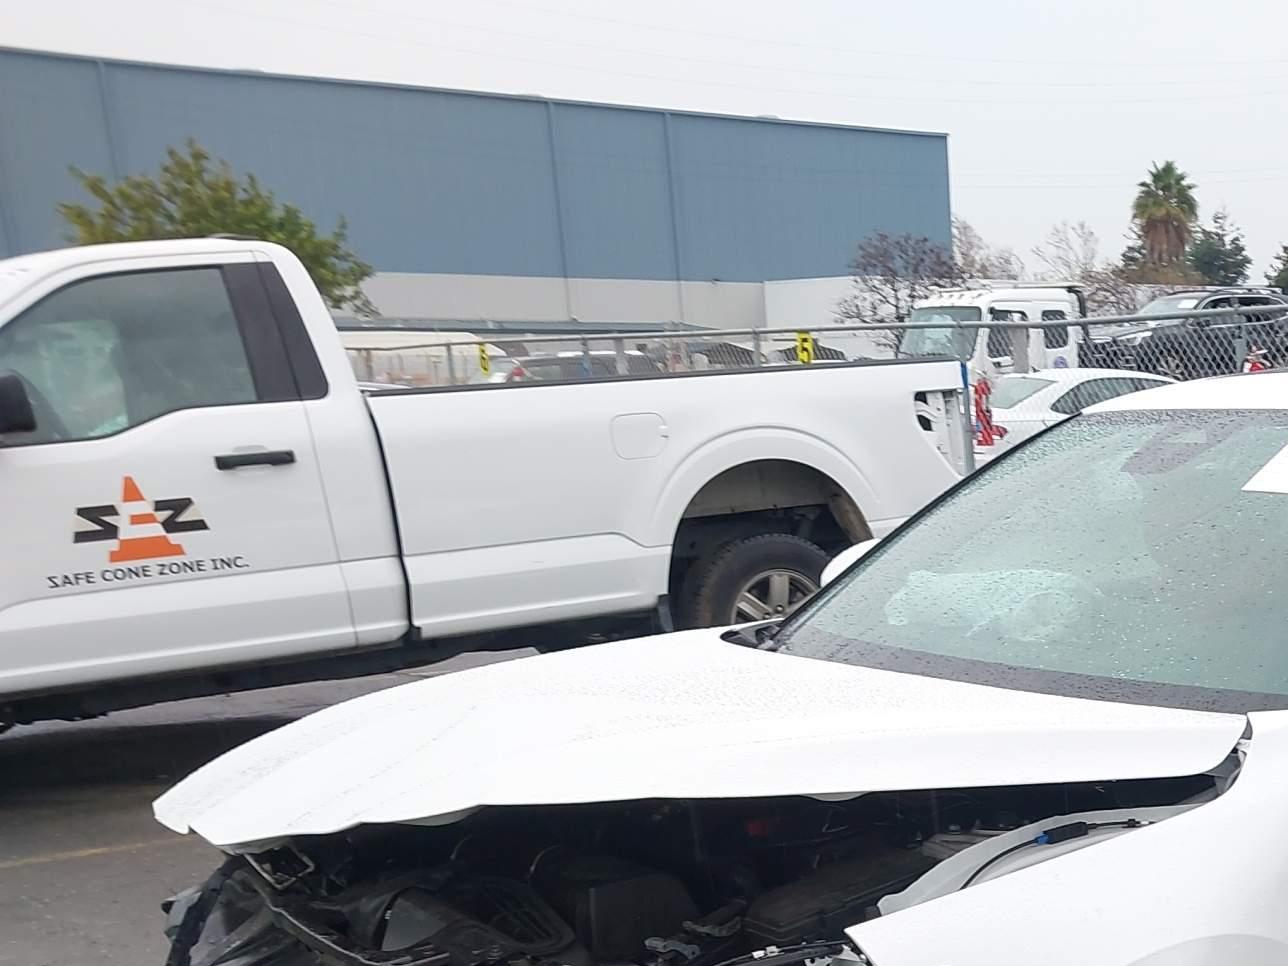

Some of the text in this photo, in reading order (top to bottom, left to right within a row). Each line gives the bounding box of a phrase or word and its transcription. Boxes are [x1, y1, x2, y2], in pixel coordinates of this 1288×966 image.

[801, 337, 811, 363] 5
[47, 556, 250, 589] SAFE CONE ZONE INC.
